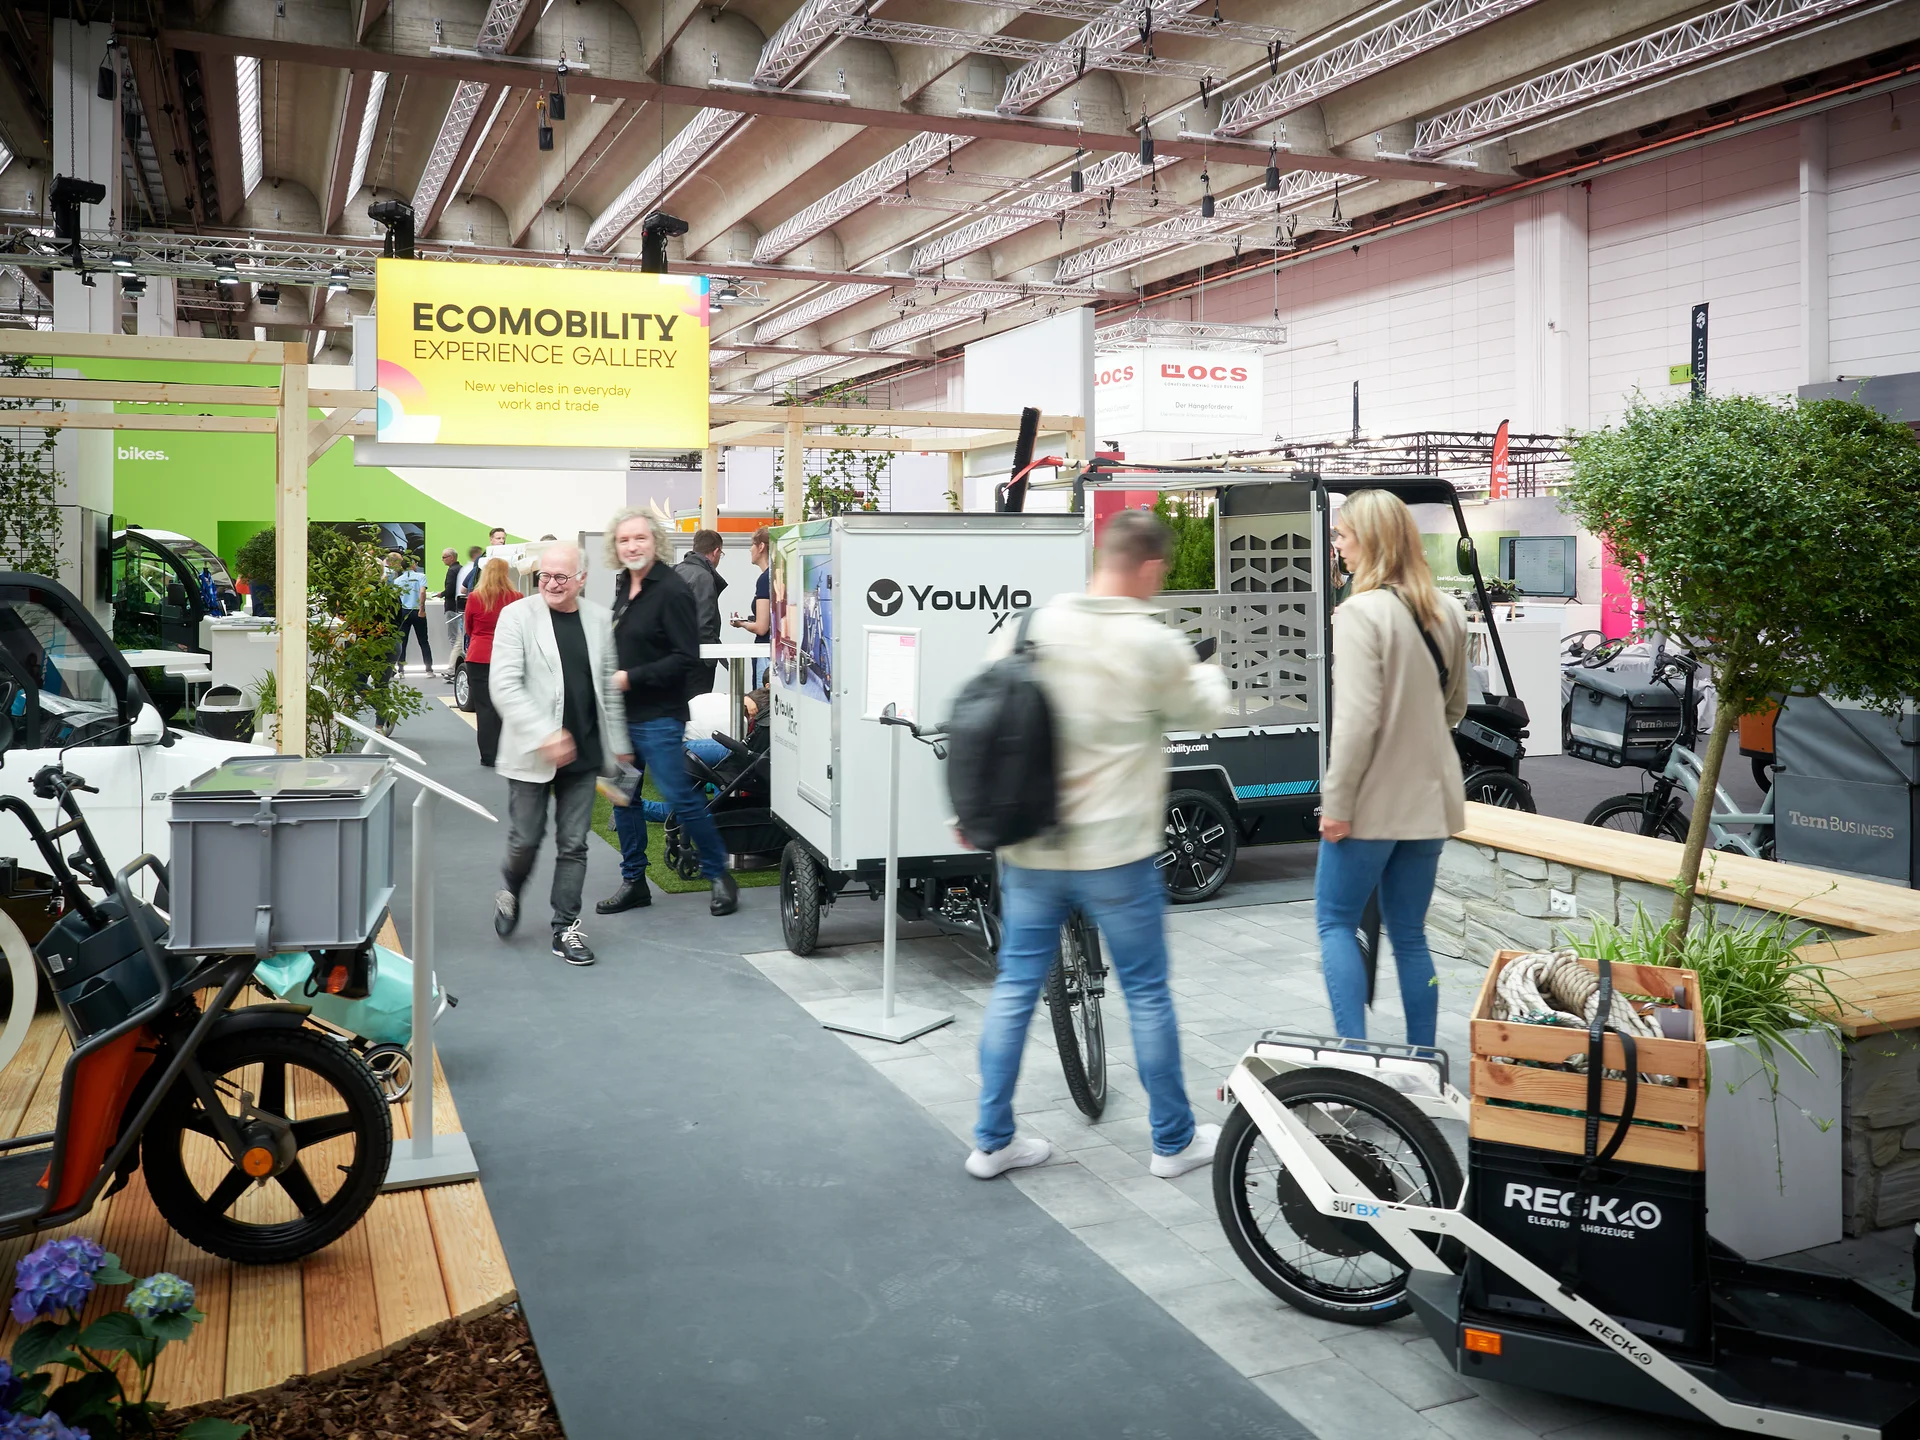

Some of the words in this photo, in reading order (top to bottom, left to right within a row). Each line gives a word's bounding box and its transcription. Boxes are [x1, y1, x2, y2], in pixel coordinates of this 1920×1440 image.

[413, 302, 678, 341] ECOMOBILITY
[414, 340, 563, 364] EXPERIENCE
[572, 346, 677, 368] GALLERY
[1161, 363, 1247, 382] LOCS
[465, 380, 495, 392] New
[500, 381, 554, 394] vehicles
[558, 383, 569, 394] in
[573, 384, 631, 398] everyday
[498, 398, 531, 410] work
[535, 400, 560, 411] and
[565, 400, 599, 411] trade
[117, 446, 170, 461] bikes.
[907, 584, 1032, 611] YouMo
